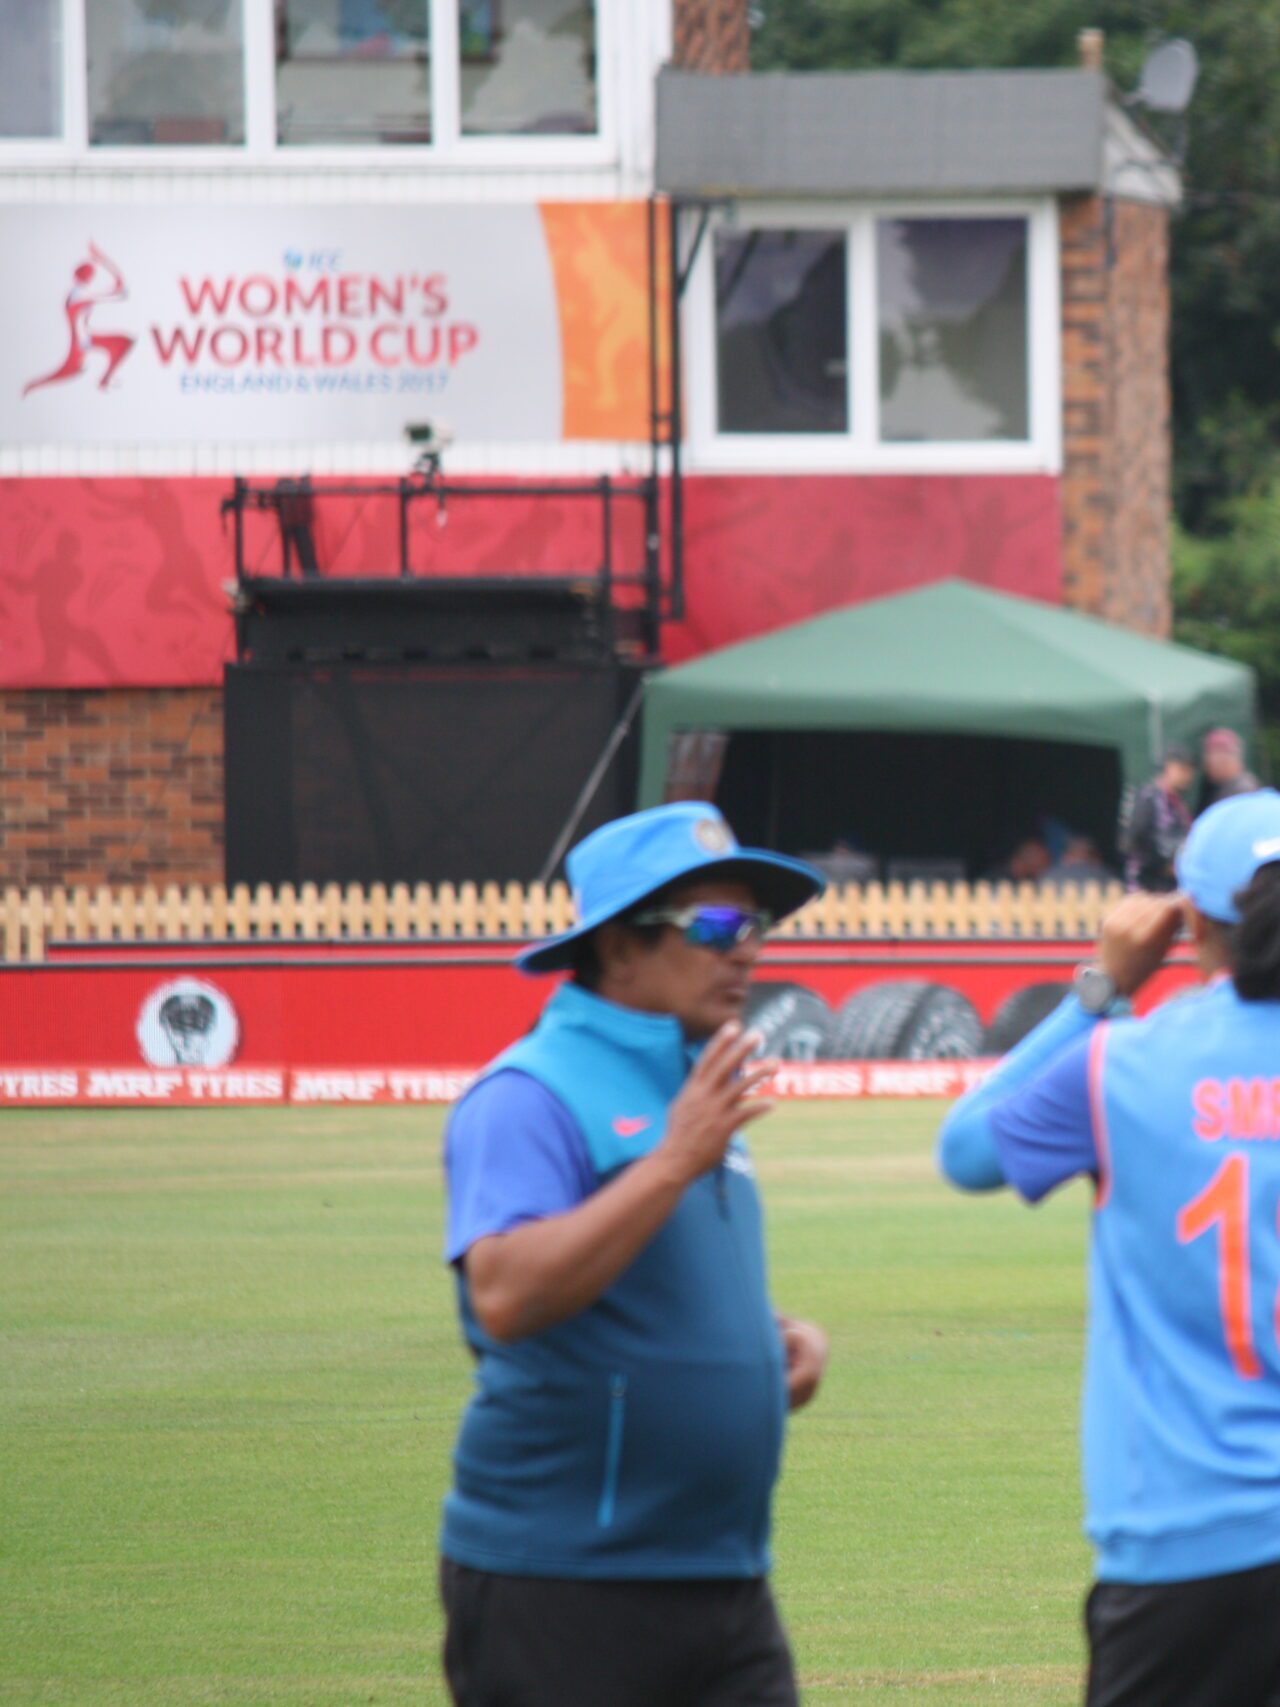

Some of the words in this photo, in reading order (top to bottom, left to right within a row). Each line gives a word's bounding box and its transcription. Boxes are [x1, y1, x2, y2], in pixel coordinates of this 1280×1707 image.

[179, 273, 449, 317] WOMEN'S
[151, 323, 358, 368] WORLD
[369, 323, 479, 368] CUP
[0, 1072, 78, 1098] YRES
[187, 1072, 283, 1099] TYRES
